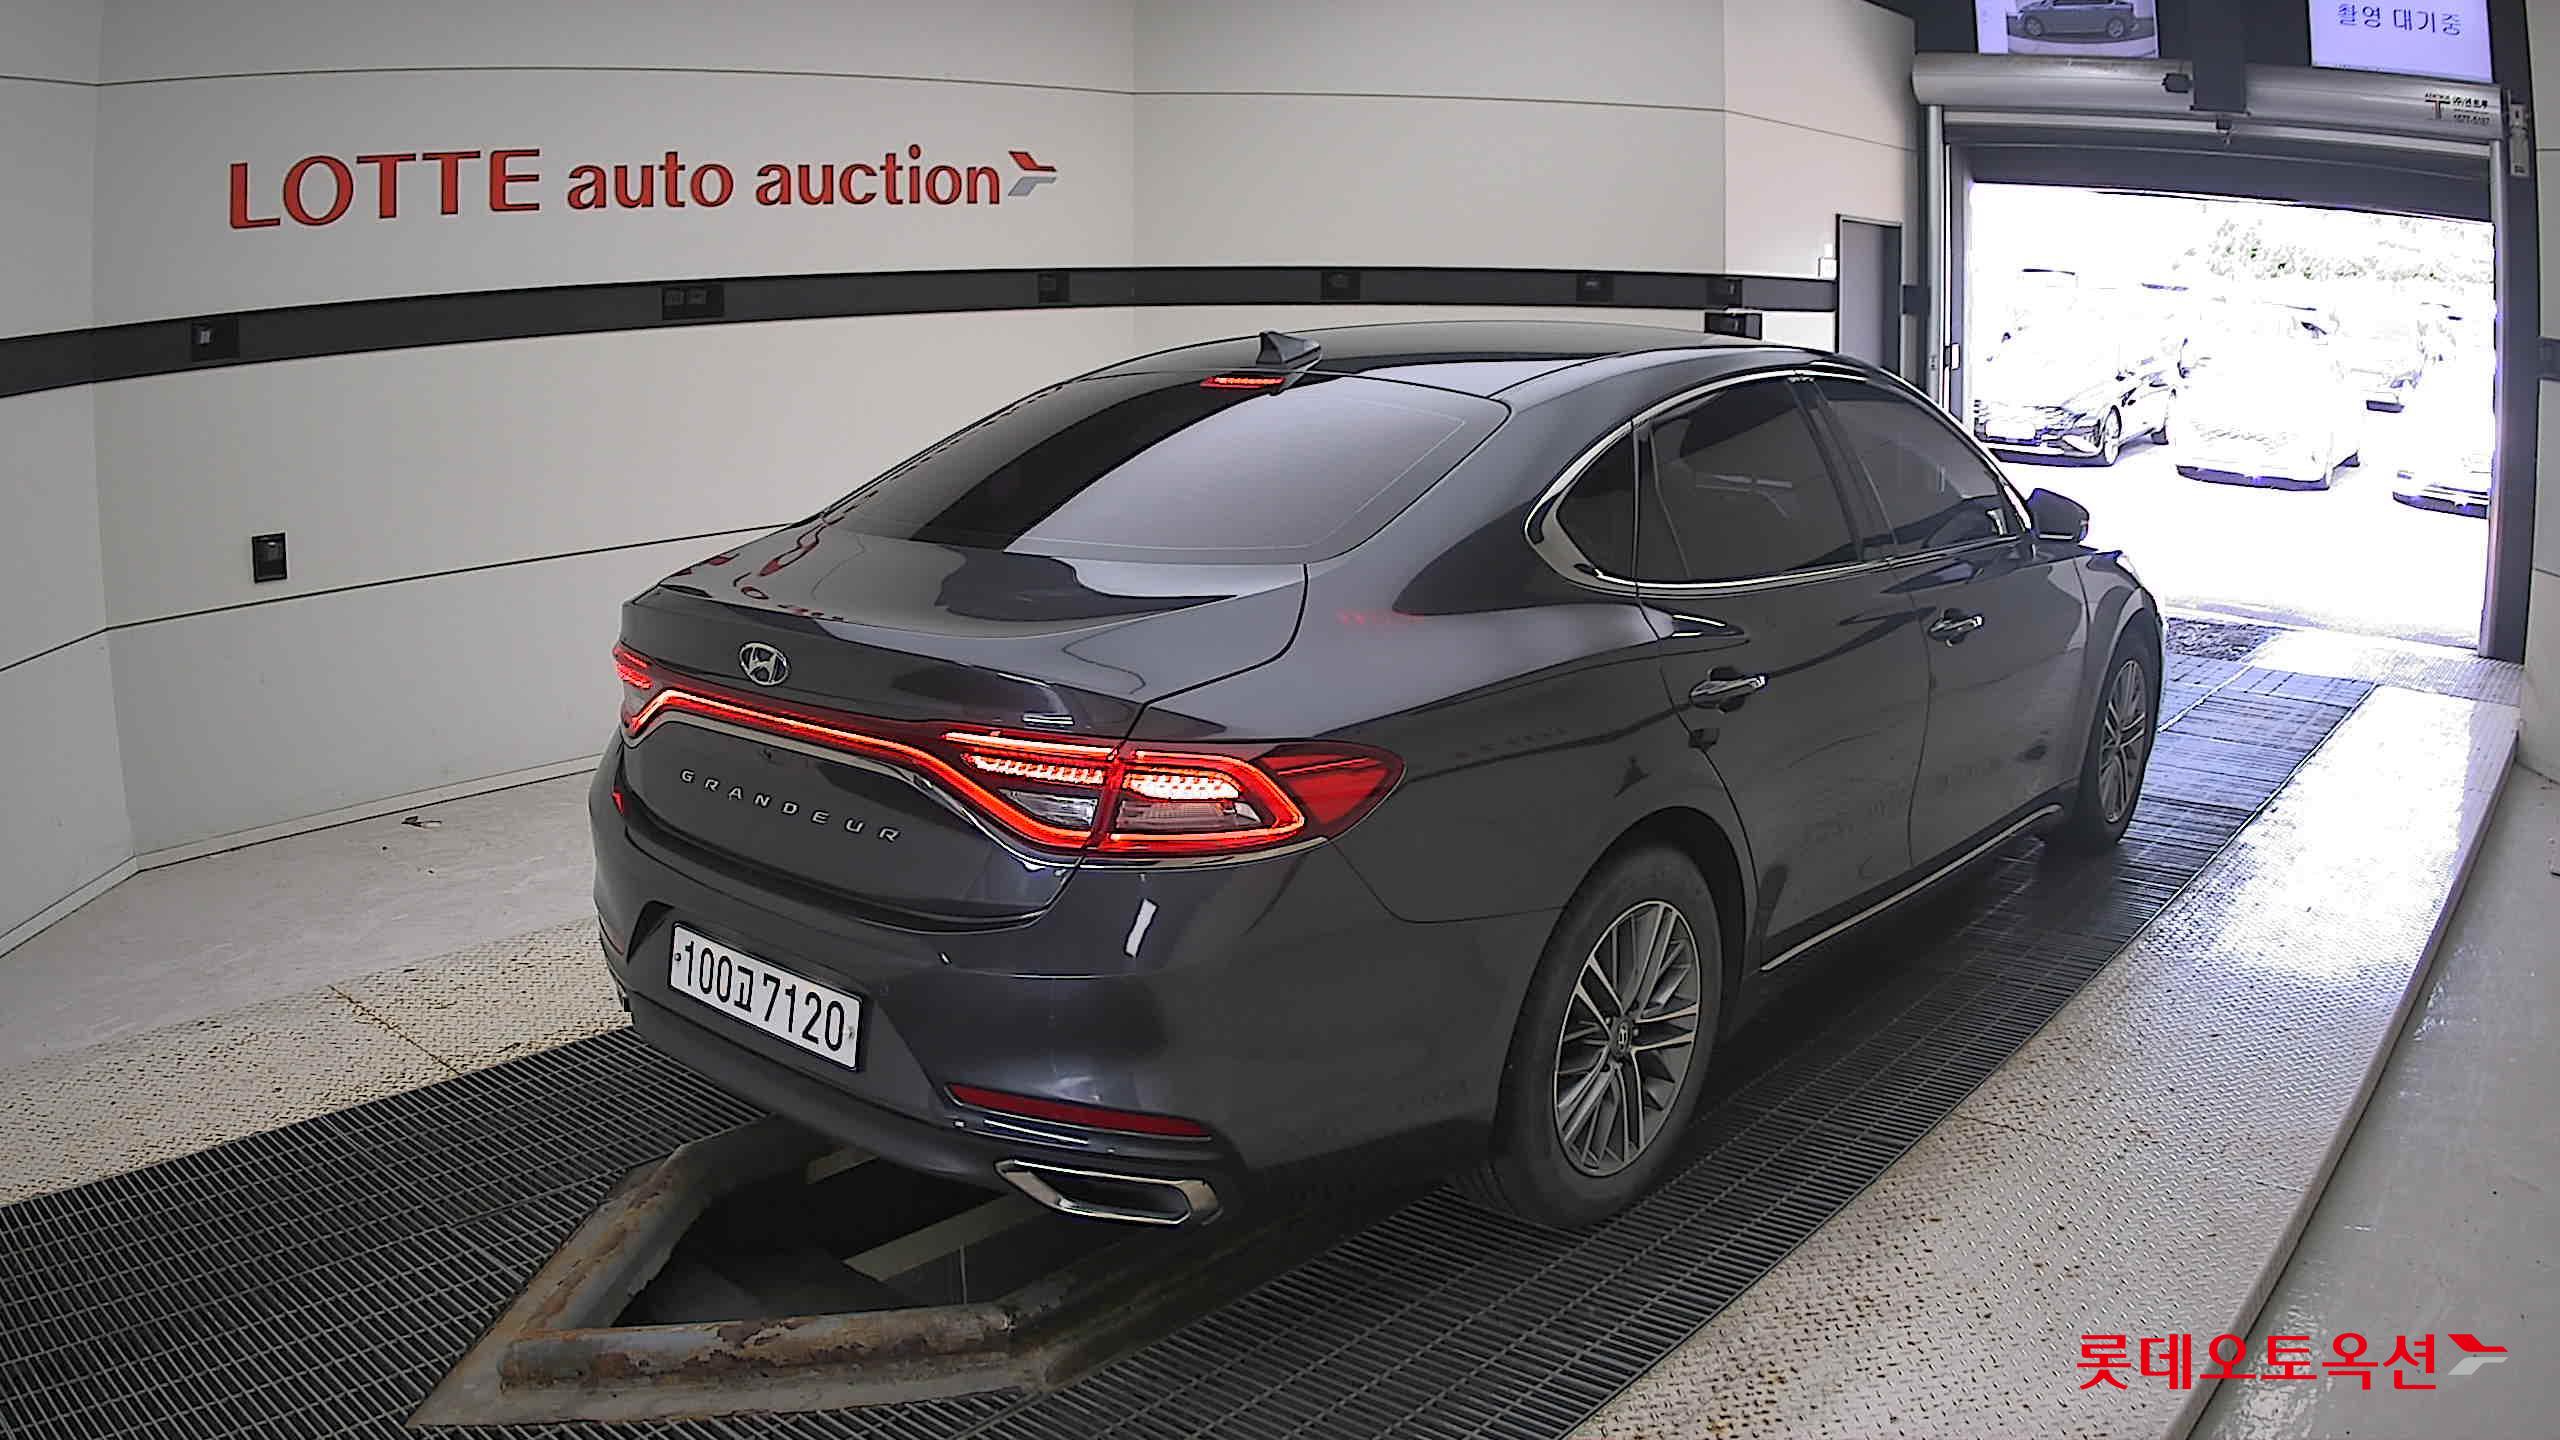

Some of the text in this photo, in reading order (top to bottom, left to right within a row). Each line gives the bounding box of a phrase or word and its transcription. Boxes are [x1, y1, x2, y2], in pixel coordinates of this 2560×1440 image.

[2338, 4, 2461, 36] 촬영 대기중
[229, 144, 1002, 230] LOTTE auto auction
[680, 769, 900, 842] GRANDEUR
